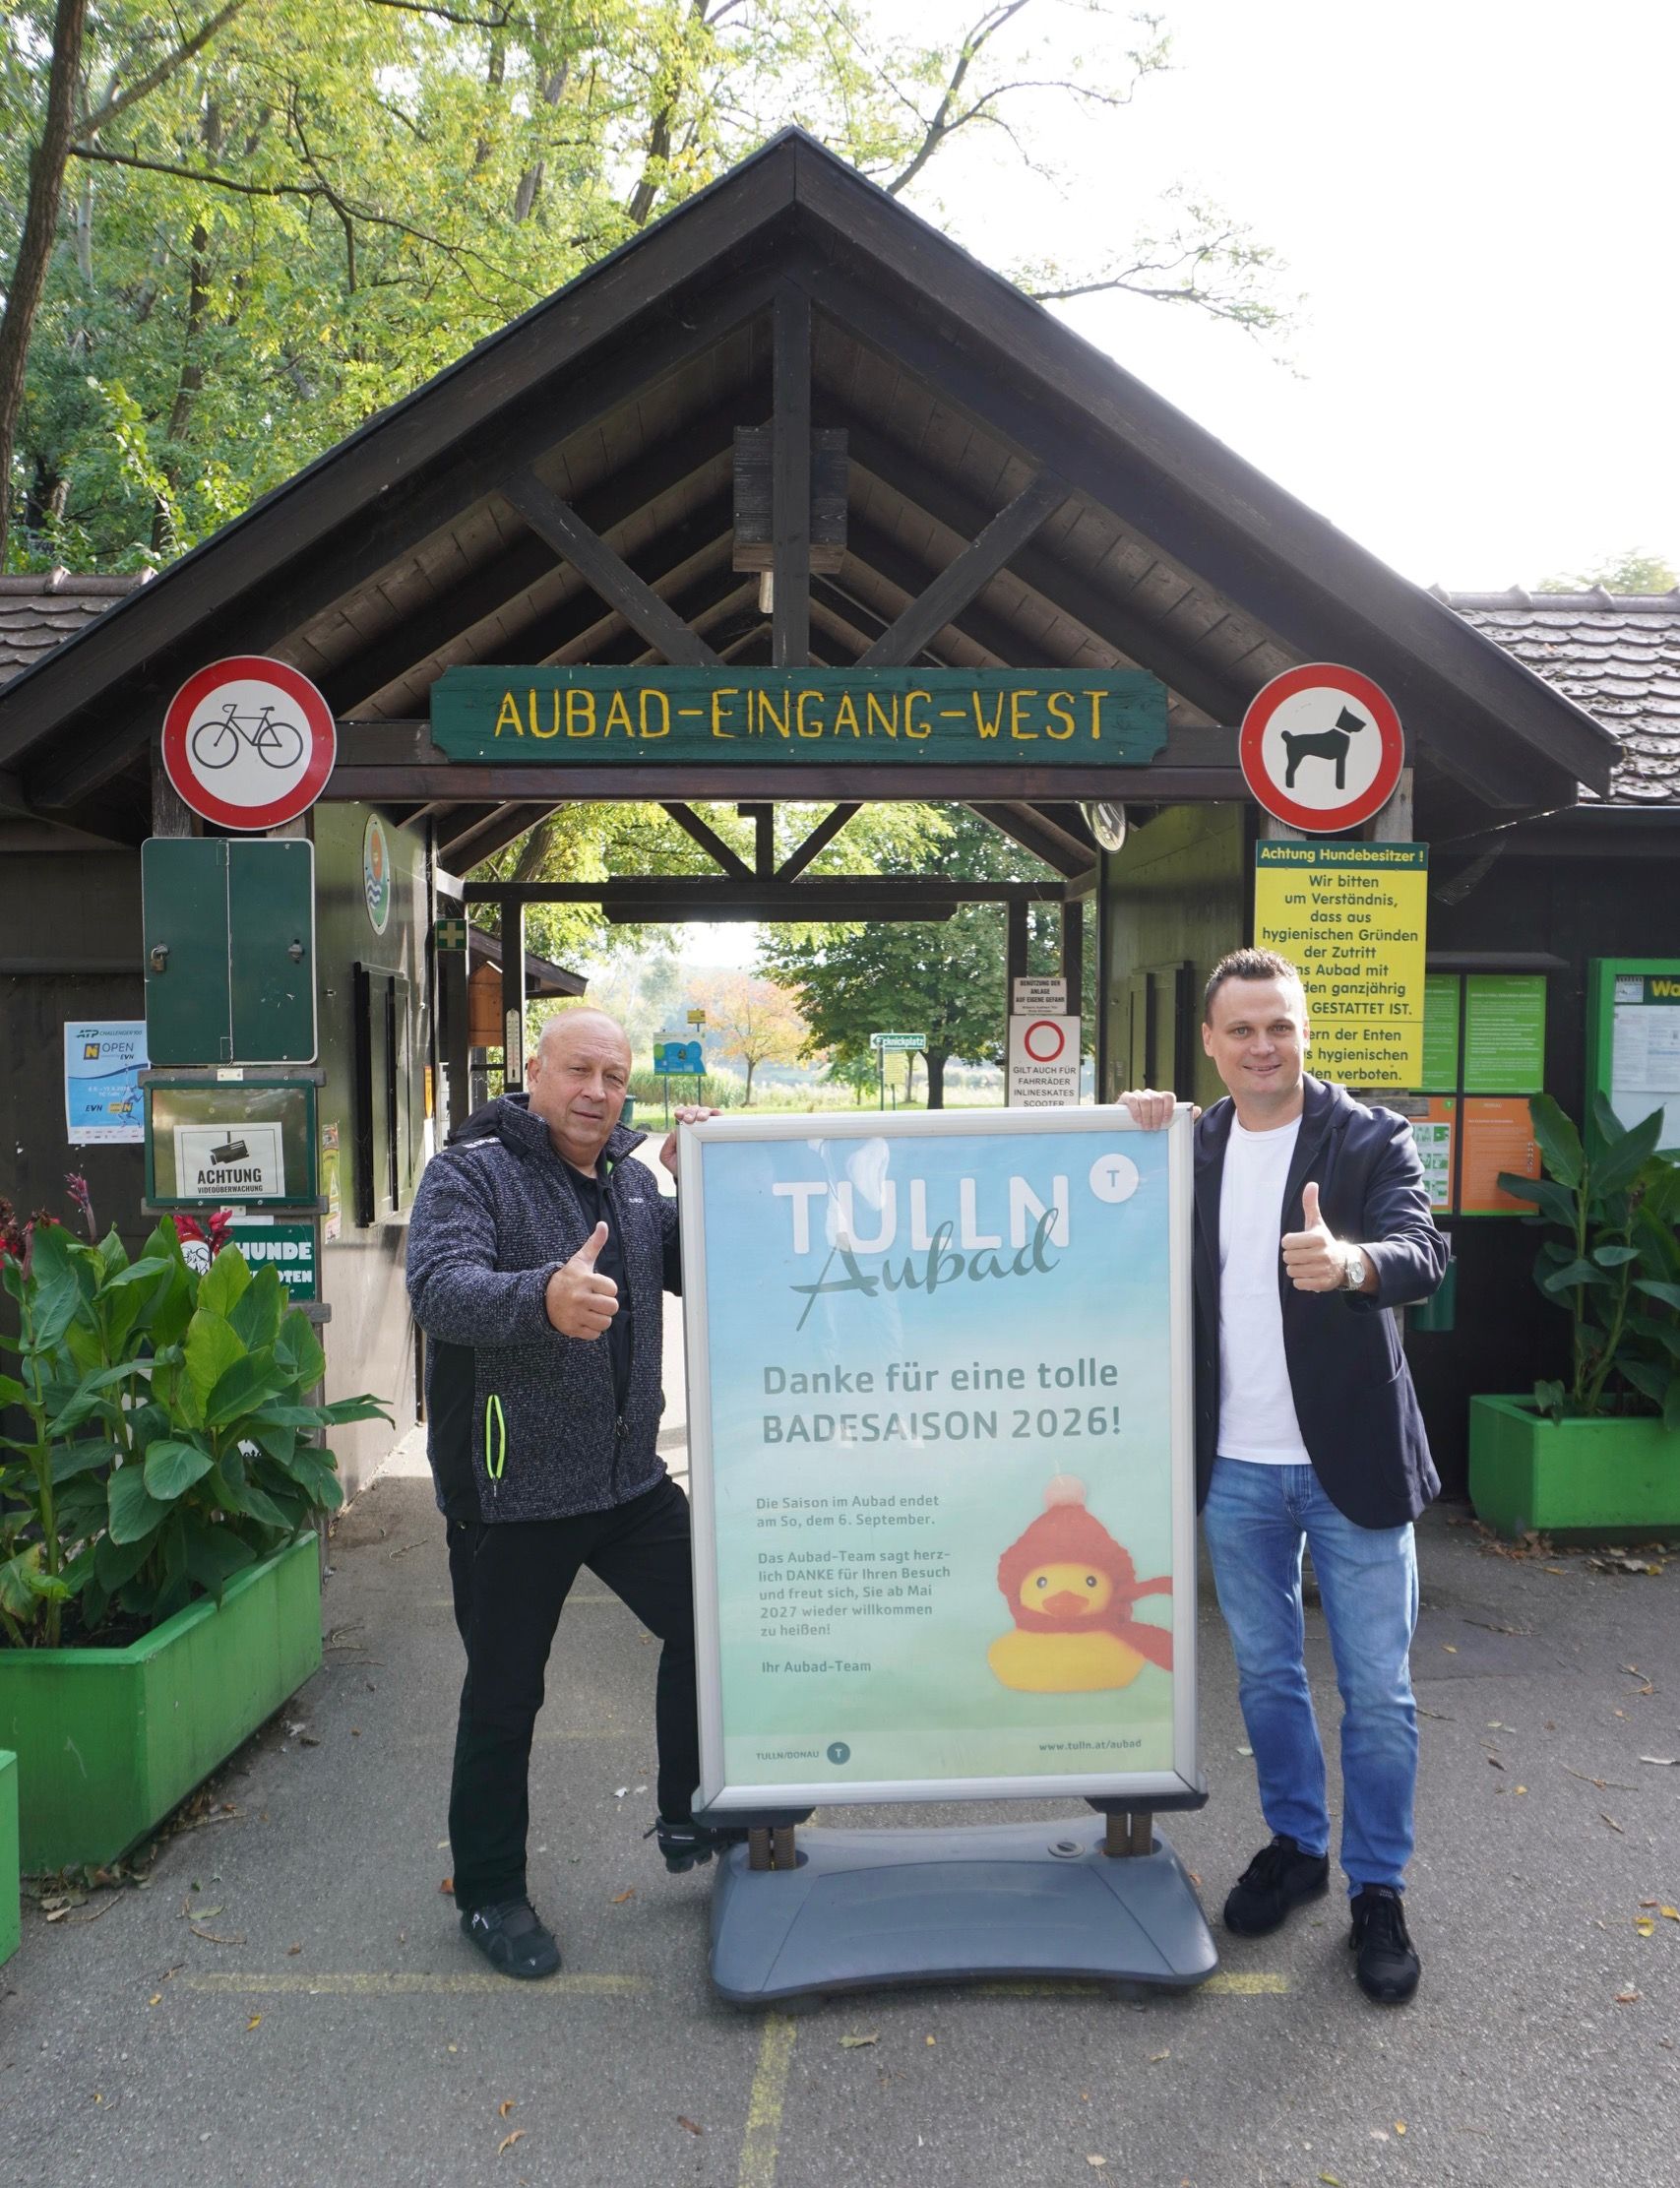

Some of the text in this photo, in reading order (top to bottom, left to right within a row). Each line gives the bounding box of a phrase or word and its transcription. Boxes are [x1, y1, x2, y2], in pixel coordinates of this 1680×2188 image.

[494, 687, 1110, 739] AUBAD-EINGANG-WEST
[1261, 846, 1424, 862] Achtung Hundebesitzer !
[1309, 875, 1380, 888] Wir bitten
[1284, 892, 1399, 907] um Verständnis,
[1310, 910, 1372, 923] dass aus
[1263, 927, 1418, 942] hygienischen Gründen
[1304, 946, 1377, 959] der Zutritt
[1295, 964, 1389, 976] ns Aubad mit
[1303, 982, 1405, 996] den ganzjährig
[1312, 1002, 1412, 1015] GESTATTET IST.
[1335, 1028, 1358, 1040] der
[1363, 1029, 1401, 1041] Enten
[101, 1042, 134, 1053] OPEN
[1318, 1046, 1408, 1062] hygienischen
[1019, 1077, 1071, 1086] FAHRRÄDER
[1338, 1067, 1402, 1081] verboten.
[198, 1167, 262, 1184] ACHTUNG
[1106, 1169, 1120, 1187] T
[198, 1184, 264, 1194] VIDEOÜBERWACHUNG
[773, 1174, 1070, 1255] TULLN
[235, 1242, 312, 1261] HUNDE
[789, 1207, 1061, 1332] Aubad
[764, 1357, 1118, 1395] Danke für eine tolle
[763, 1406, 1121, 1444] BADESAISON 2026!
[756, 1494, 940, 1510] Die Saison im Aubad endet
[757, 1513, 936, 1529] am So, dem 6. September.
[758, 1548, 951, 1565] Das Aubad-Team sagt herz-
[758, 1566, 951, 1583] lich DANKE für Ihren Besuch
[759, 1585, 932, 1600] und freut sich, Sie ab Mai
[760, 1603, 933, 1619] 2027 wieder willkommen
[761, 1624, 831, 1637] zu heißen!
[762, 1660, 872, 1673] Ihr Aubad-Team
[1039, 1739, 1142, 1751] www.tulln.at/aubad
[756, 1748, 842, 1761] TULLN/DONAU T
